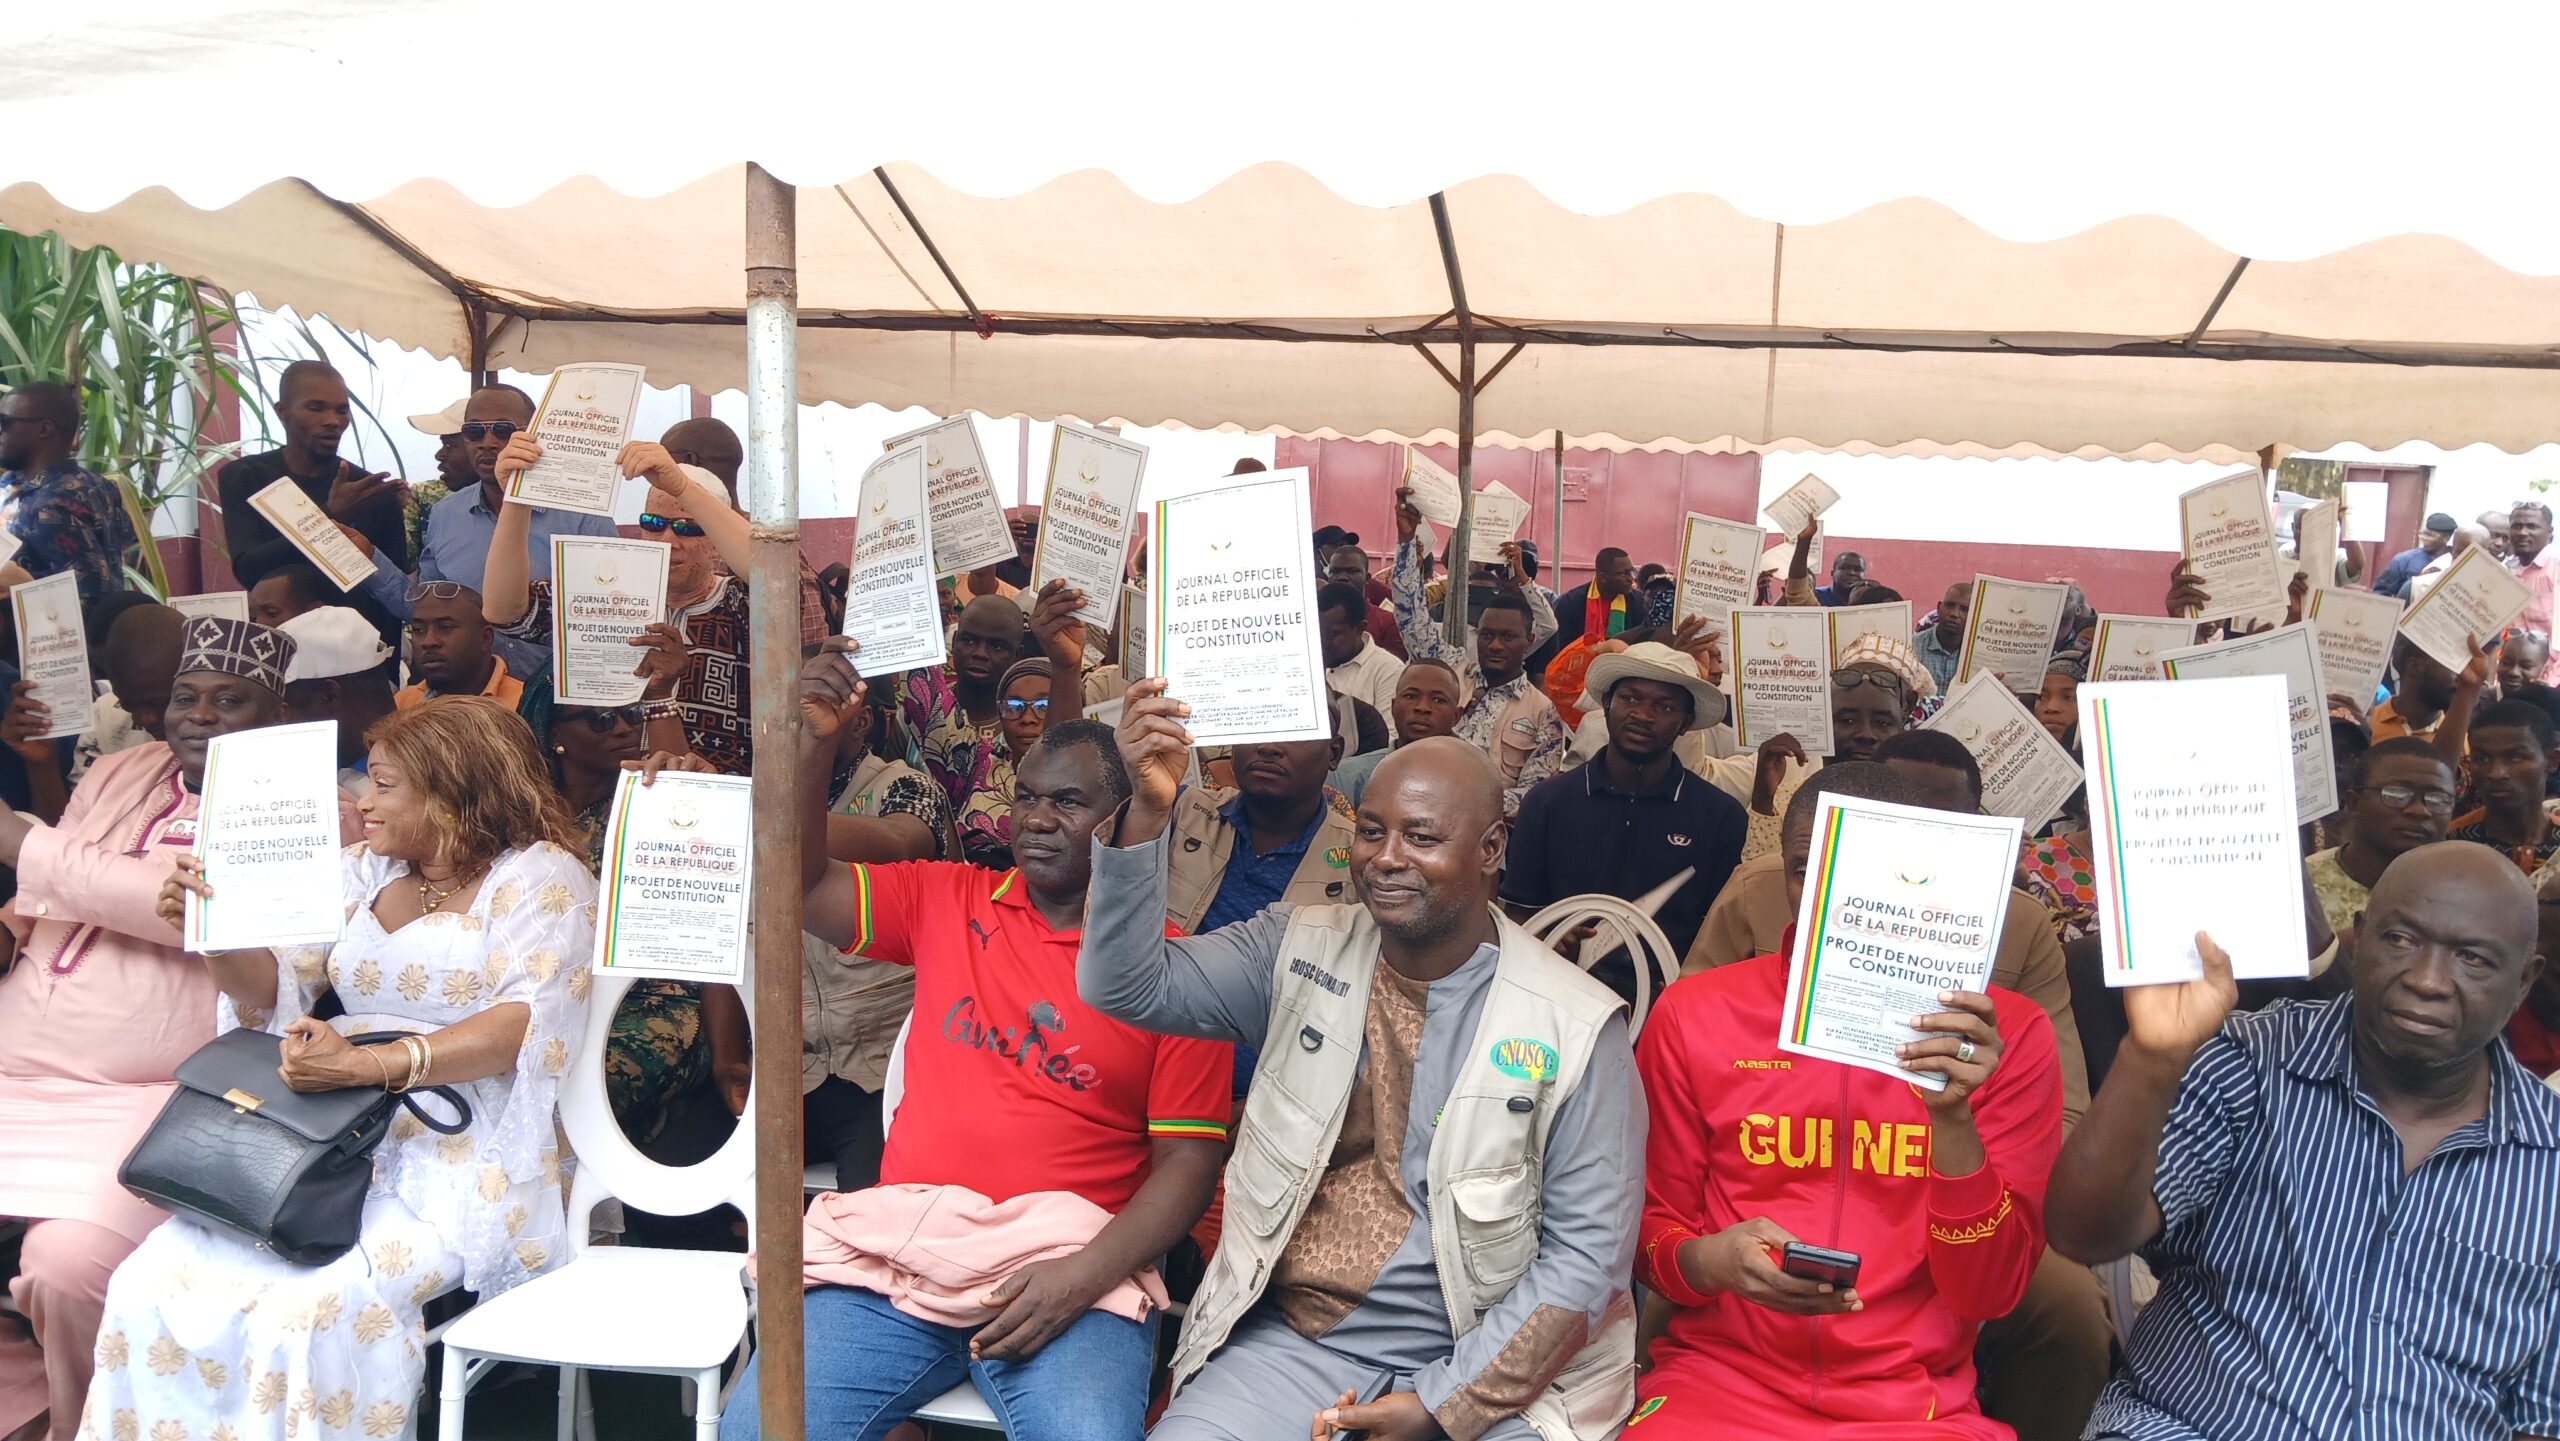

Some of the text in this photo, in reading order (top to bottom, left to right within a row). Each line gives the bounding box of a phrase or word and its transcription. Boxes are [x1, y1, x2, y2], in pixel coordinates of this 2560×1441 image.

[548, 410, 620, 424] JOURNAL OFFICIEL
[537, 432, 566, 442] PROJET
[578, 437, 620, 450] NOUVELLE
[547, 443, 606, 457] CONSTITUTION
[946, 467, 978, 481] OFFICIEL
[942, 502, 951, 510] DE
[954, 489, 990, 507] NOUVELLE
[1054, 499, 1061, 508] DE
[1063, 501, 1071, 511] LA
[1056, 487, 1121, 516] JOURNAL OFFICIEL
[932, 502, 983, 522] CONSTITUTION
[883, 520, 916, 536] OFFICIEL
[1048, 516, 1121, 549] PROJET DE NOUVELLE
[2194, 519, 2259, 541] JOURNAL OFFICIEL
[1053, 530, 1107, 556] CONSTITUTION
[2191, 552, 2216, 563] PROJET
[2229, 540, 2269, 554] NOUVELLE
[869, 567, 878, 578] DE
[880, 556, 924, 575] NOUVELLE
[1691, 560, 1746, 575] JOURNAL OFFICIEL
[2204, 552, 2260, 569] CONSTITUTION
[855, 572, 913, 595] CONSTITUTION
[1176, 567, 1289, 590] JOURNAL OFFICIEL
[1177, 585, 1289, 606] DE LA REPUBLIQUE
[1684, 579, 1703, 590] PROJET
[1713, 586, 1747, 597] NOUVELLE
[1691, 589, 1737, 603] CONSTITUTION
[572, 595, 649, 606] JOURNAL OFFICIEL
[568, 623, 597, 632] PROJET
[598, 624, 609, 632] DE
[1169, 612, 1302, 634] PROJET DE NOUVELLE
[1986, 619, 2016, 628] JOURNAL
[1186, 631, 1285, 649] CONSTITUTION
[1977, 636, 2001, 645] PROJET
[2318, 631, 2351, 641] JOURNAL
[1986, 646, 2037, 654] CONSTITUTION
[2346, 657, 2381, 668] NOUVELLE
[1755, 692, 1812, 701] CONSTITUTION
[1991, 718, 2019, 745] OFFICIEL
[2291, 725, 2320, 742] VELLE
[1998, 764, 2010, 775] DE
[2007, 732, 2040, 767] NOUVELLE
[1992, 747, 2038, 794] CONSTITUTION
[270, 800, 316, 811] OFFICIEL
[235, 818, 247, 827] LA
[252, 814, 316, 826] REPUBLIQUE
[209, 836, 328, 851] PROJET DE NOUVELLE
[635, 842, 736, 857] JOURNAL OFFICIEL
[227, 851, 313, 864] CONSTITUTION
[636, 855, 734, 870] DE LA REPUBLIQUE
[624, 876, 741, 893] PROJET DE NOUVELLE
[642, 890, 724, 903] CONSTITUTION
[1844, 896, 1984, 928] JOURNAL OFFICIEL
[1844, 912, 1980, 946] DE LA REPUBLIQUE
[1826, 936, 1984, 975] PROJET DE NOUVELLE
[1850, 956, 1963, 991] CONSTITUTION
